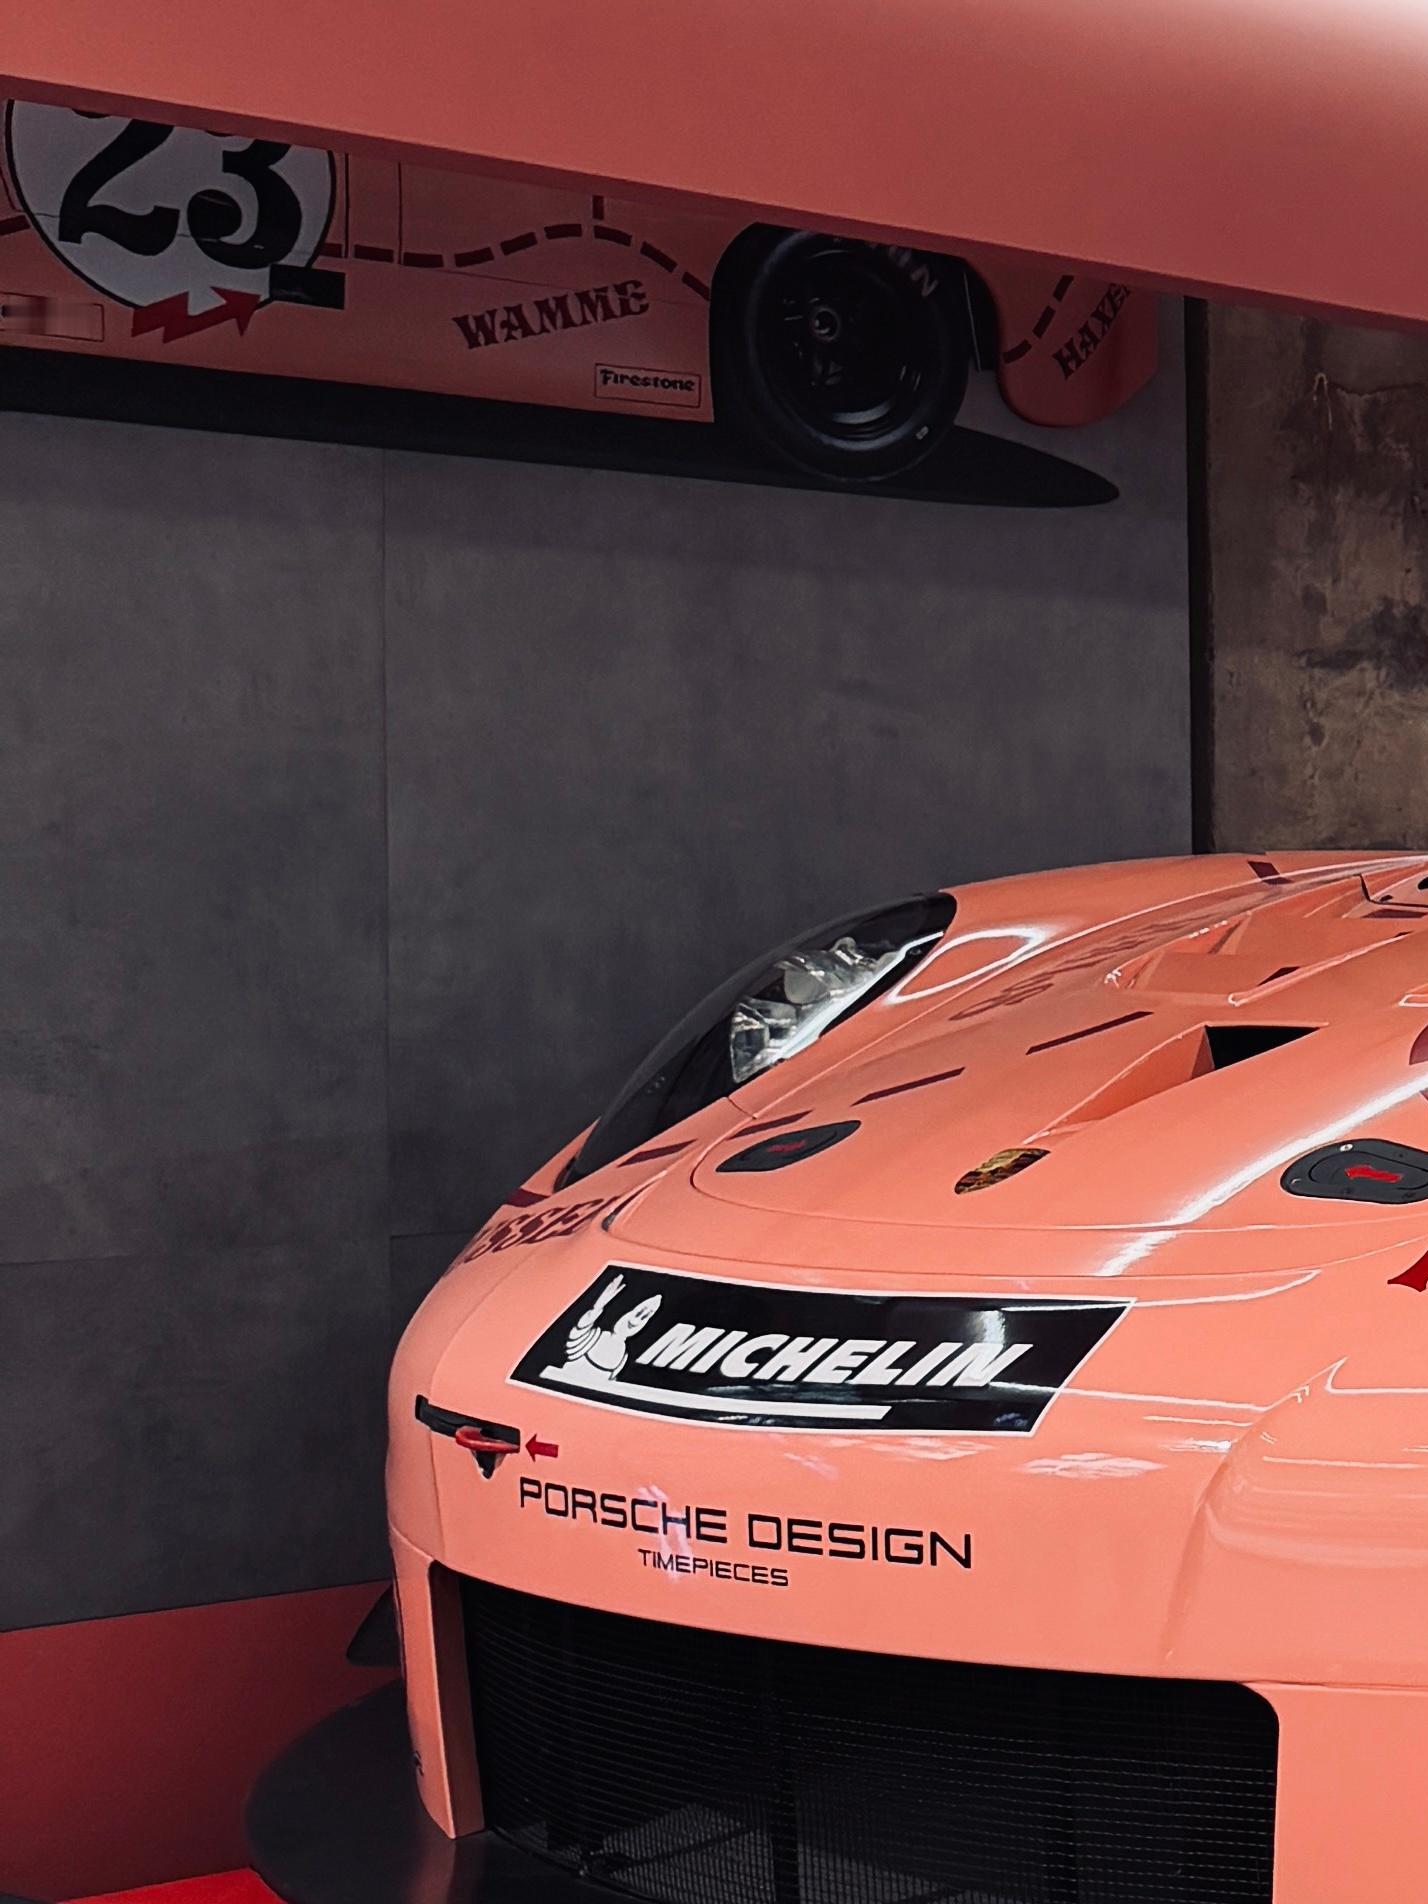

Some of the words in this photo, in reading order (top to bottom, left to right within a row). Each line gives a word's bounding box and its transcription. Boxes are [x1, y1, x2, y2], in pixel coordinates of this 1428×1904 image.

[452, 279, 649, 350] WAMME
[600, 368, 695, 393] Firestone
[636, 1321, 1034, 1388] MICHELIN
[520, 1476, 727, 1544] PORSCHE
[748, 1512, 973, 1569] DESIGN
[638, 1547, 790, 1587] TIMEPIECES
